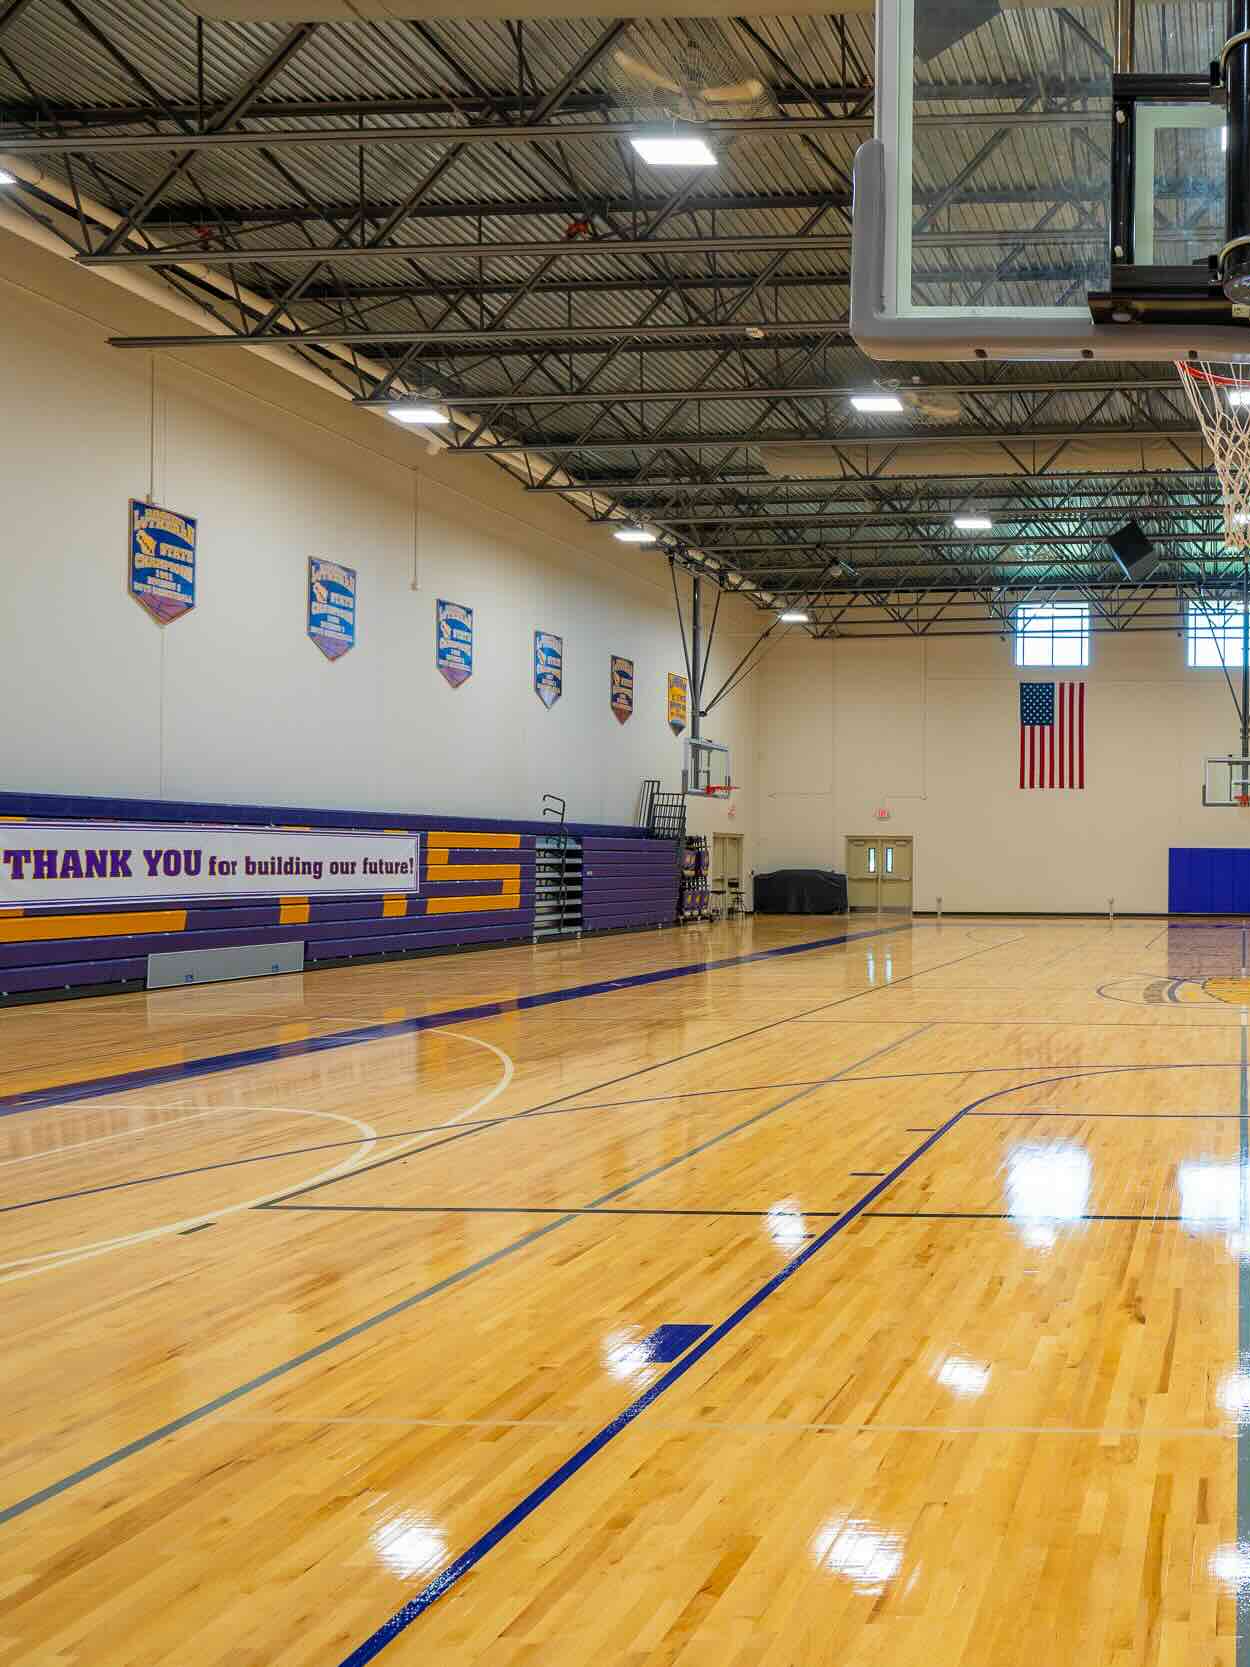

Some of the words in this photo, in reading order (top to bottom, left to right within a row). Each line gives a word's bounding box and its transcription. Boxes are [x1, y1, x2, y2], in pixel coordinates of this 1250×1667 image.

[3, 849, 132, 880] THANK
[142, 848, 202, 877] YOU
[208, 856, 238, 877] for
[244, 855, 323, 880] building
[329, 859, 357, 875] our
[362, 857, 415, 875] future!
